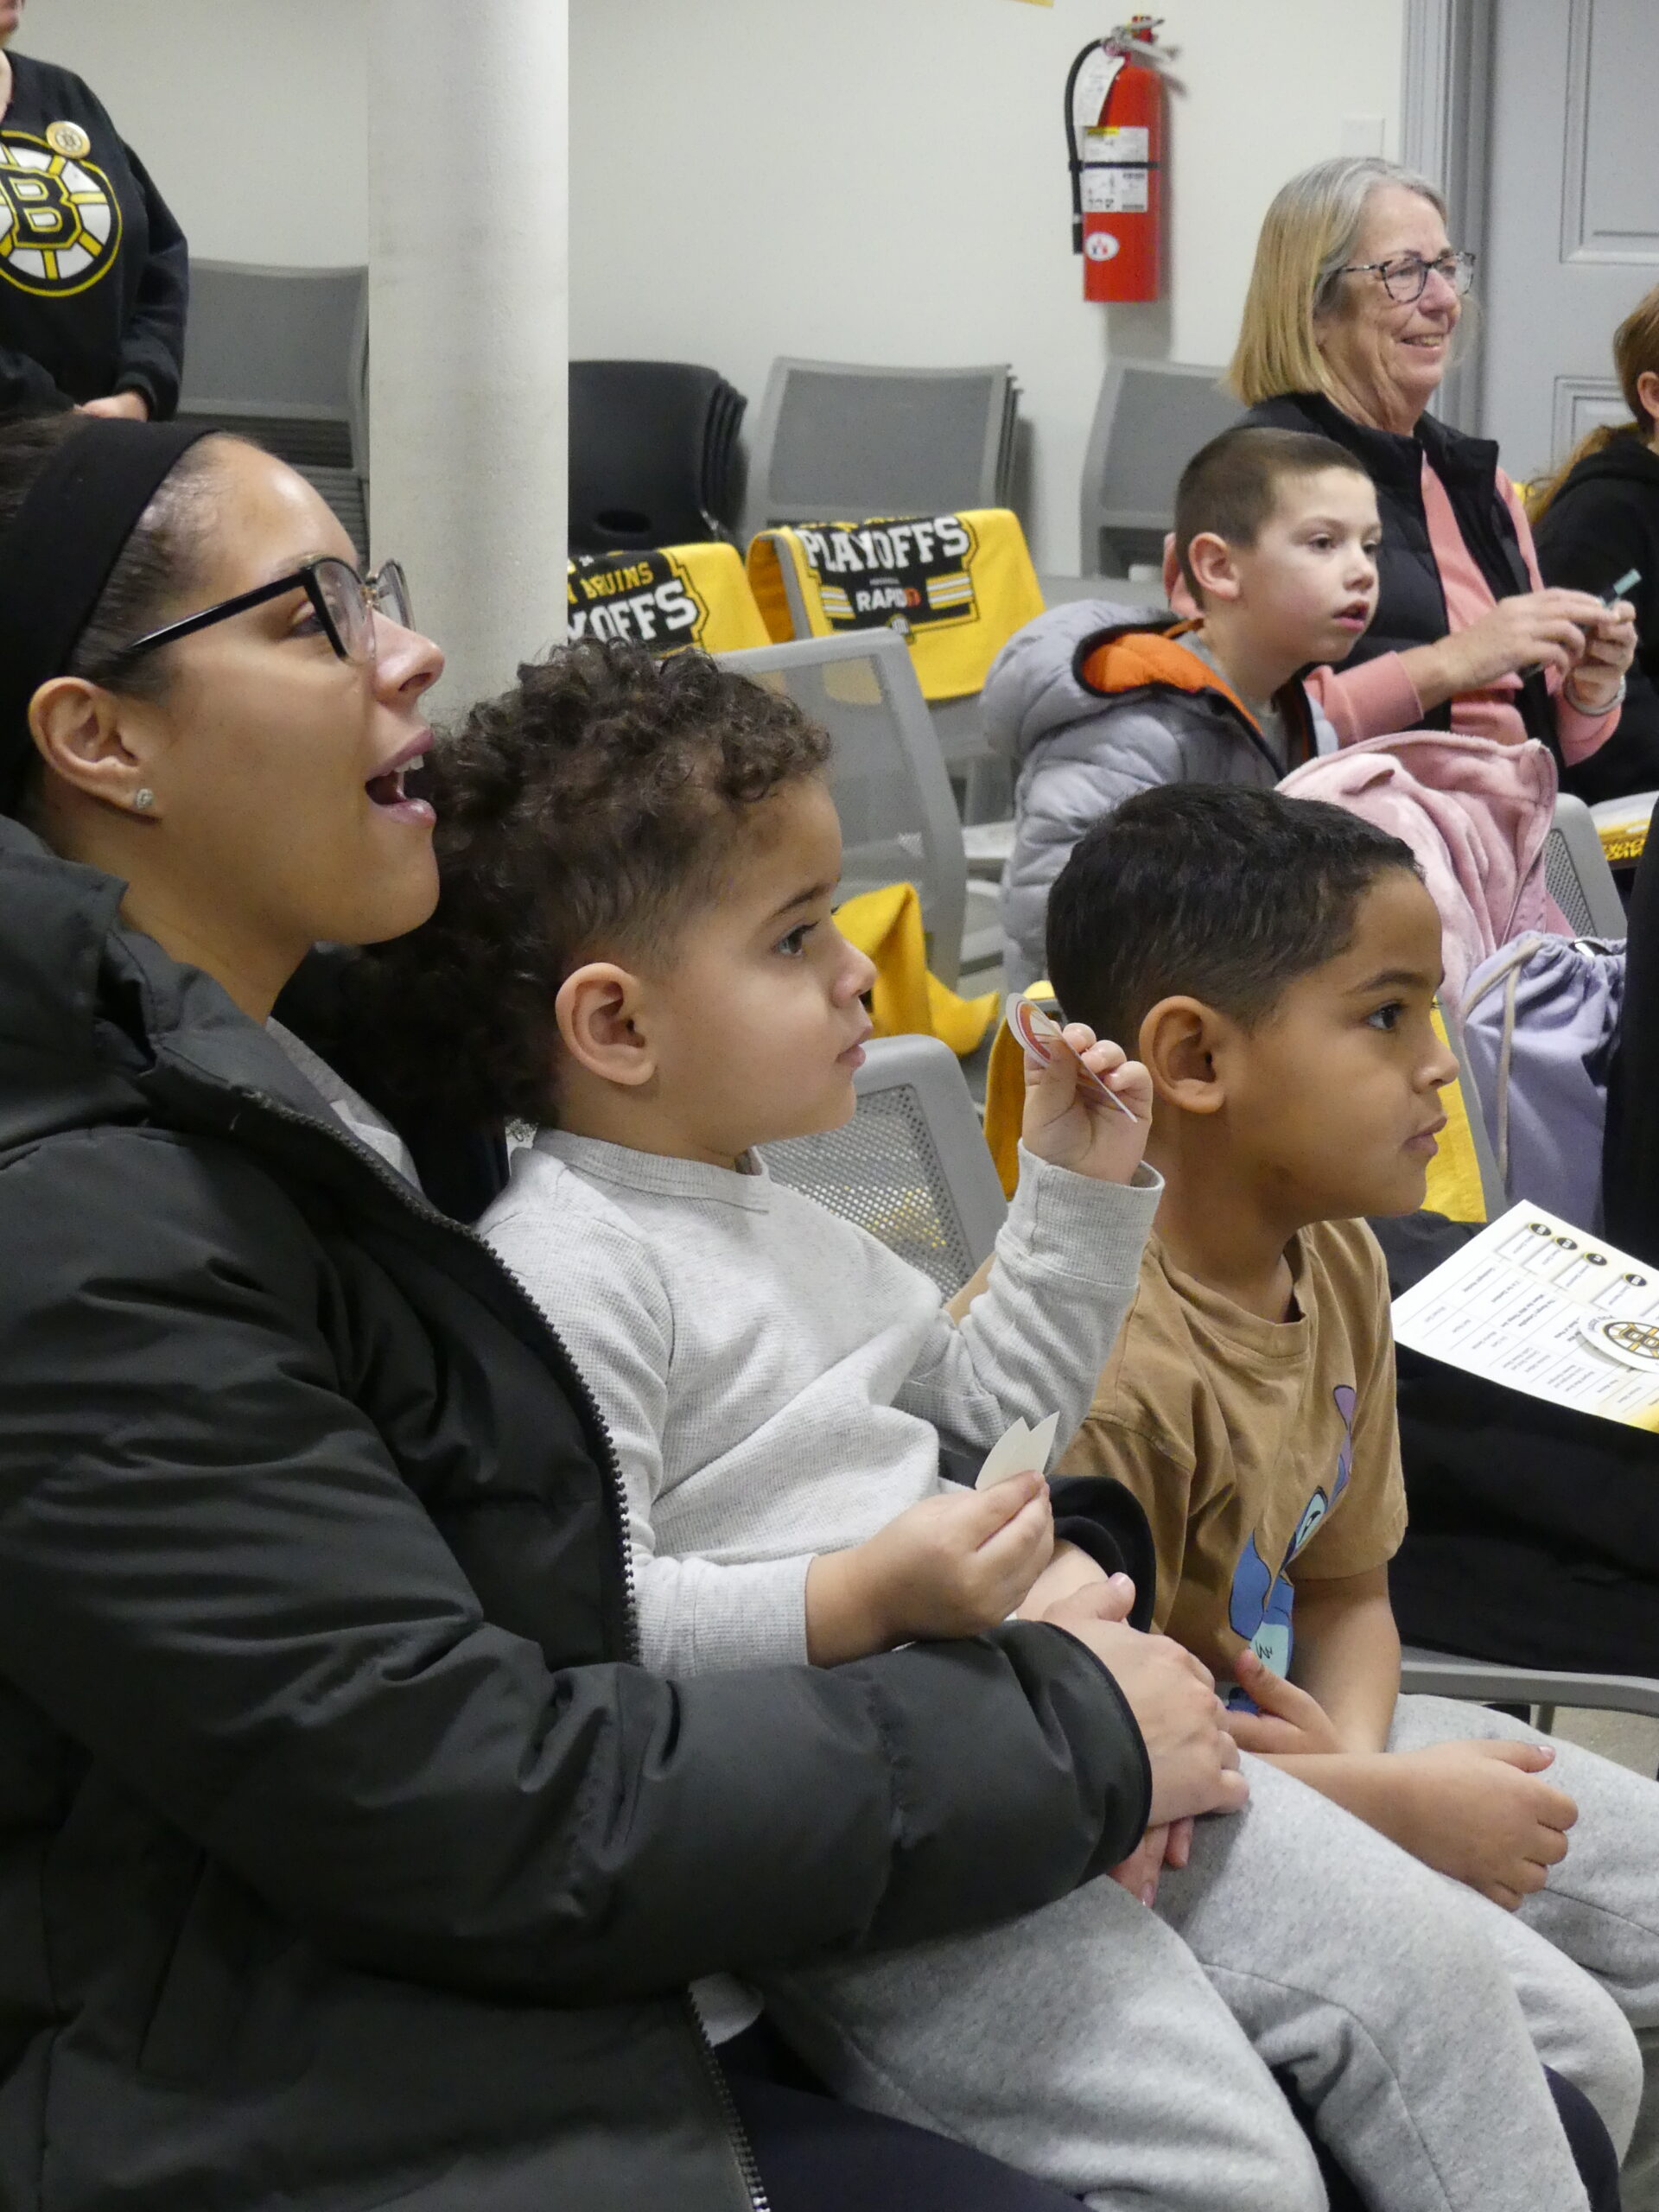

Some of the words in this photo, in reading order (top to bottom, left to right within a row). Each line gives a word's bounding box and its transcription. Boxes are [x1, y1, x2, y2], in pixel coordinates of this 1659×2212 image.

[0, 164, 82, 250] B
[793, 516, 969, 572] PLAYOFFS
[580, 561, 654, 600] BRUINS
[568, 580, 698, 642] YOFFS
